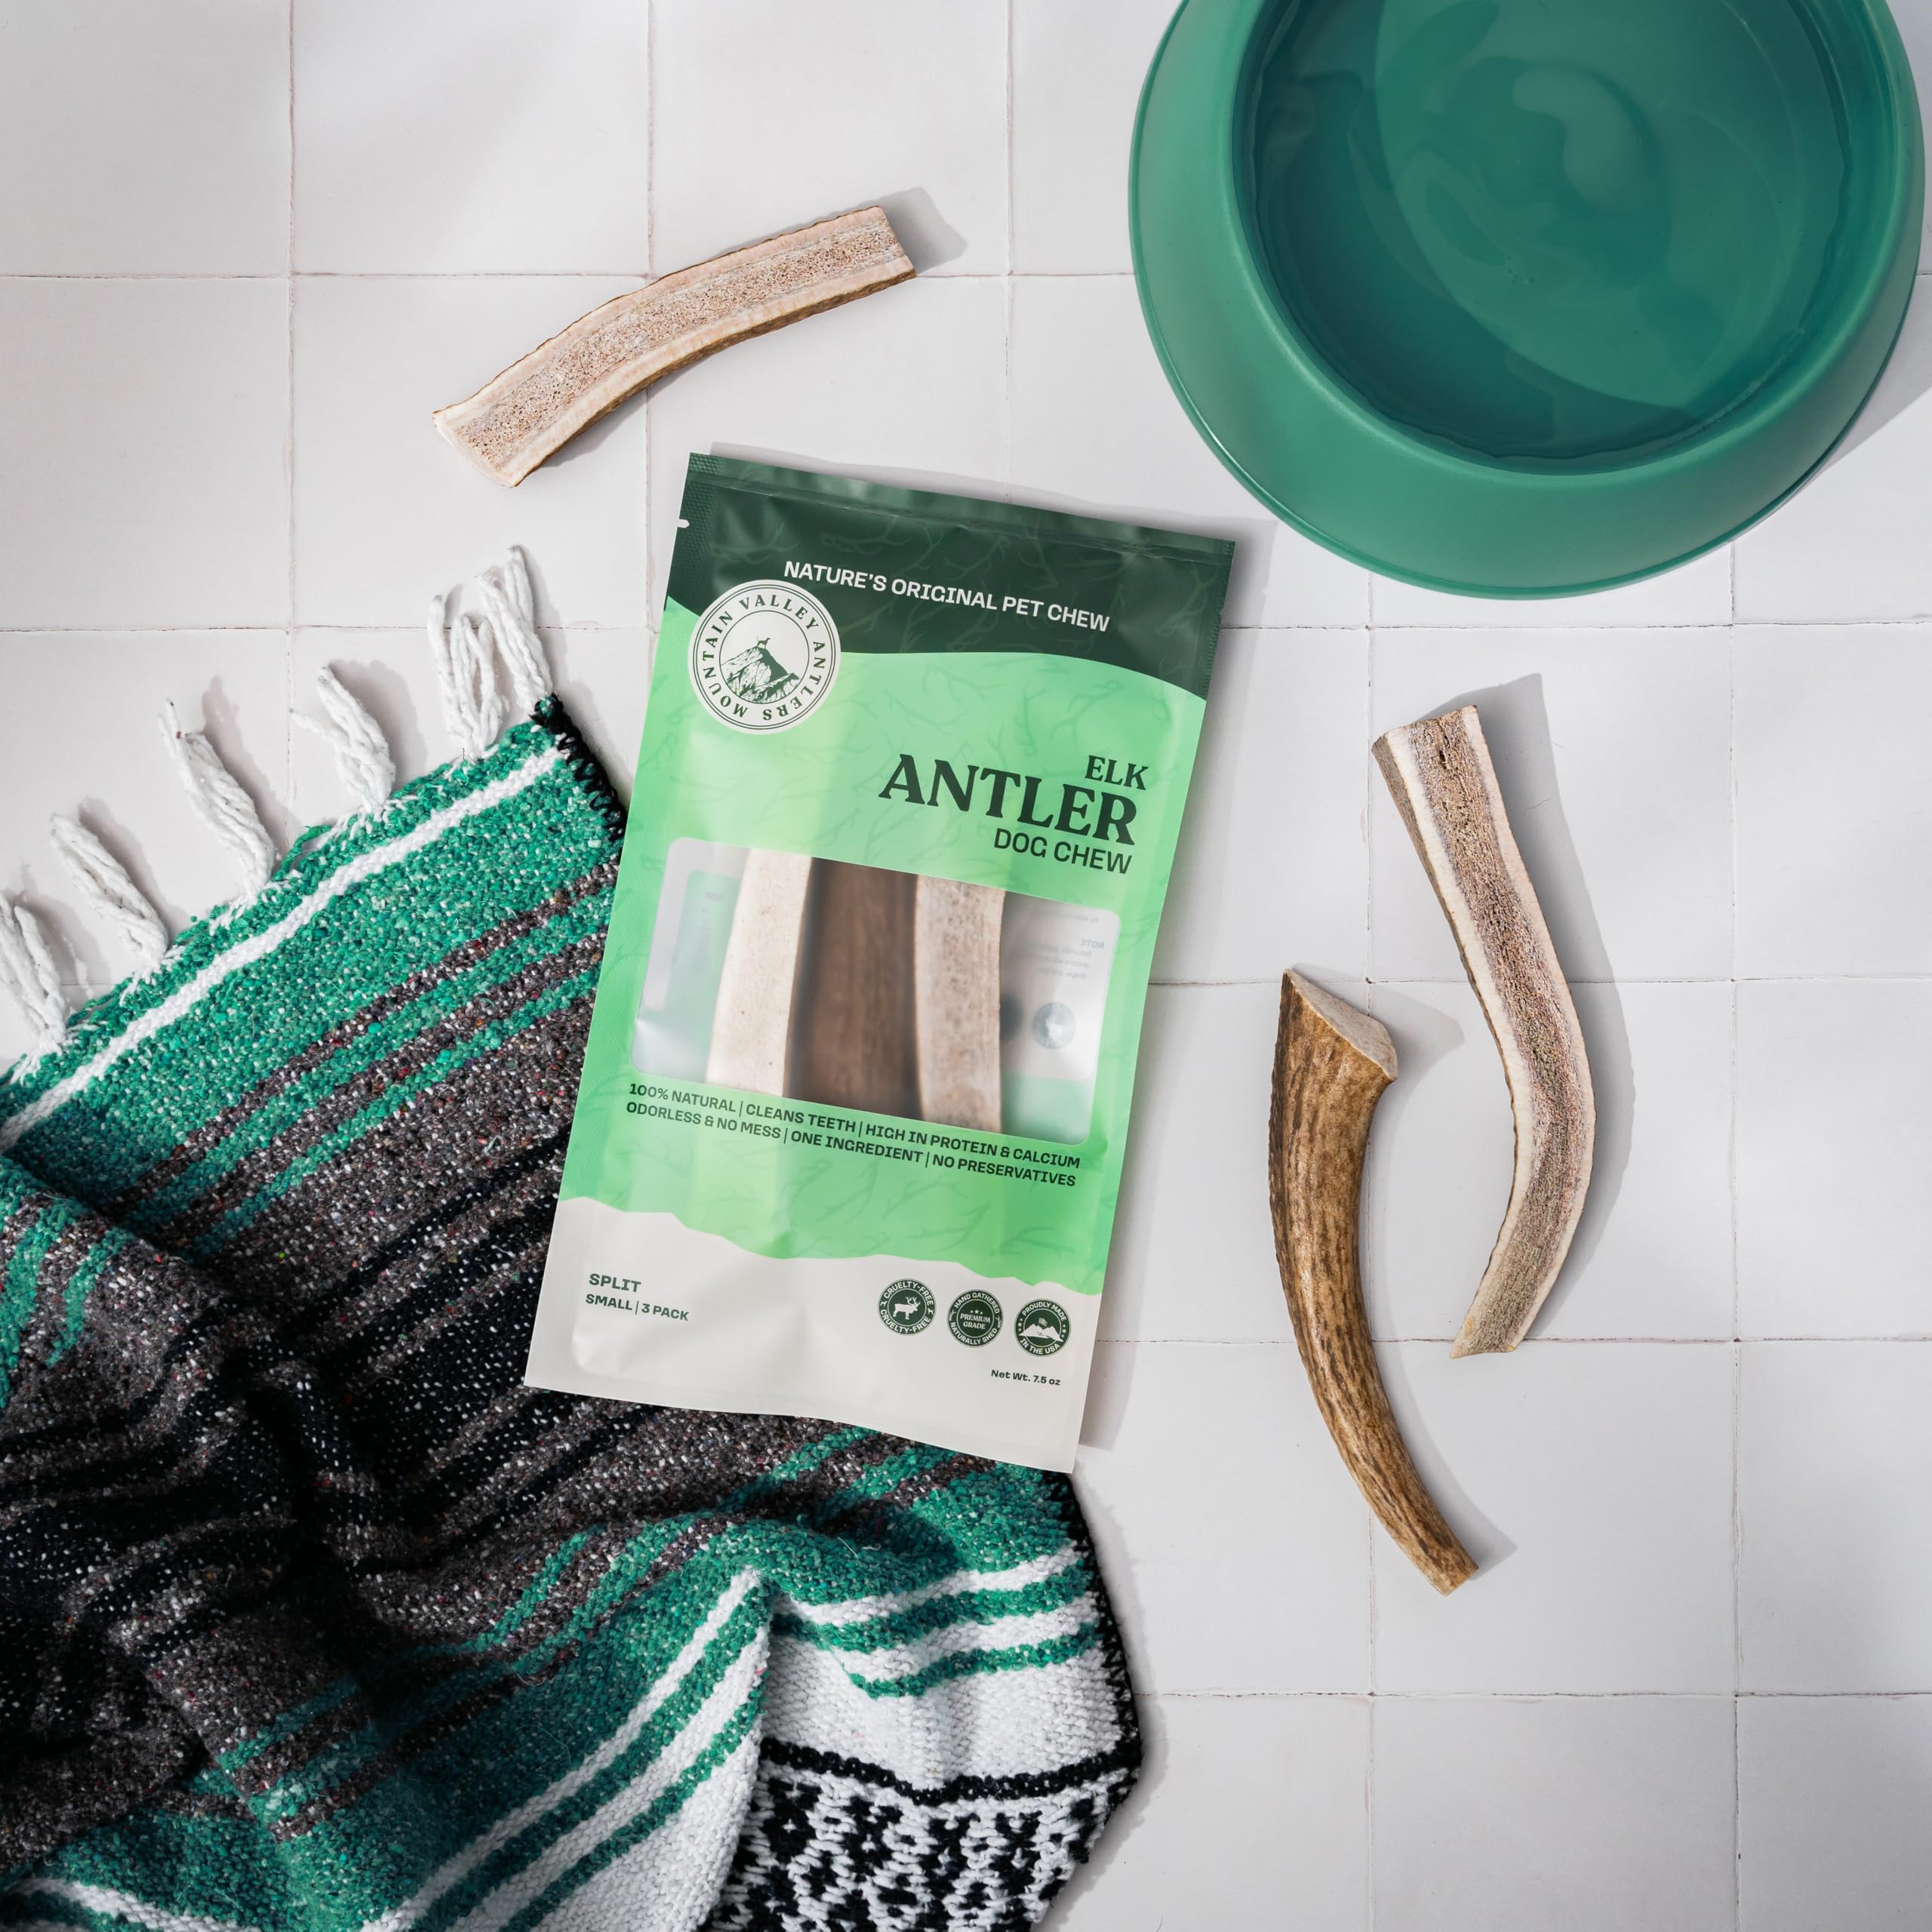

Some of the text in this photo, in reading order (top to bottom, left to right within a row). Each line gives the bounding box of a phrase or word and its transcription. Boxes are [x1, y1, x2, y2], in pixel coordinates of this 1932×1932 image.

[784, 561, 1110, 632] NATURE’S ORIGINAL PET CHEW
[703, 594, 826, 720] MOUNTAIN VALLEY ANTLERS
[1084, 755, 1149, 790] ELK
[878, 753, 1137, 845] ANTLER
[994, 828, 1132, 875] DOG CHEW
[629, 1083, 669, 1100] 100%
[672, 1091, 736, 1112] NATURAL
[746, 1103, 804, 1124] CLEANS
[808, 1113, 857, 1133] TEETH
[865, 1124, 906, 1141] HIGH
[908, 1131, 928, 1145] IN
[930, 1134, 998, 1157] PROTEIN
[1000, 1146, 1011, 1158] &
[1013, 1148, 1081, 1169] CALCIUM
[626, 1101, 702, 1124] ODORLESS
[704, 1115, 715, 1127] &
[717, 1117, 737, 1131] NO
[740, 1121, 781, 1139] MESS
[791, 1131, 823, 1146] ONE
[825, 1136, 923, 1163] INGREDIENT
[932, 1154, 955, 1168] NO
[958, 1158, 1076, 1186] PRESERVATIVES
[589, 1273, 641, 1292] SPLIT
[884, 1281, 934, 1306] CRUELTY-FREE
[586, 1294, 632, 1310] SMALL
[641, 1303, 650, 1313] 3
[653, 1305, 689, 1321] PACK
[954, 1292, 1000, 1314] HAND GATHERED
[1022, 1301, 1067, 1322] PROUDLY MADE
[880, 1309, 931, 1334] CRUELTY-FREE
[960, 1313, 991, 1323] PREMIUM
[963, 1321, 986, 1330] GRADE
[950, 1321, 998, 1345] NATURALLY SHED
[1020, 1337, 1061, 1355] IN THE USA
[991, 1369, 1011, 1380] Net
[1013, 1372, 1031, 1382] Wt.
[1032, 1375, 1047, 1384] 7.5
